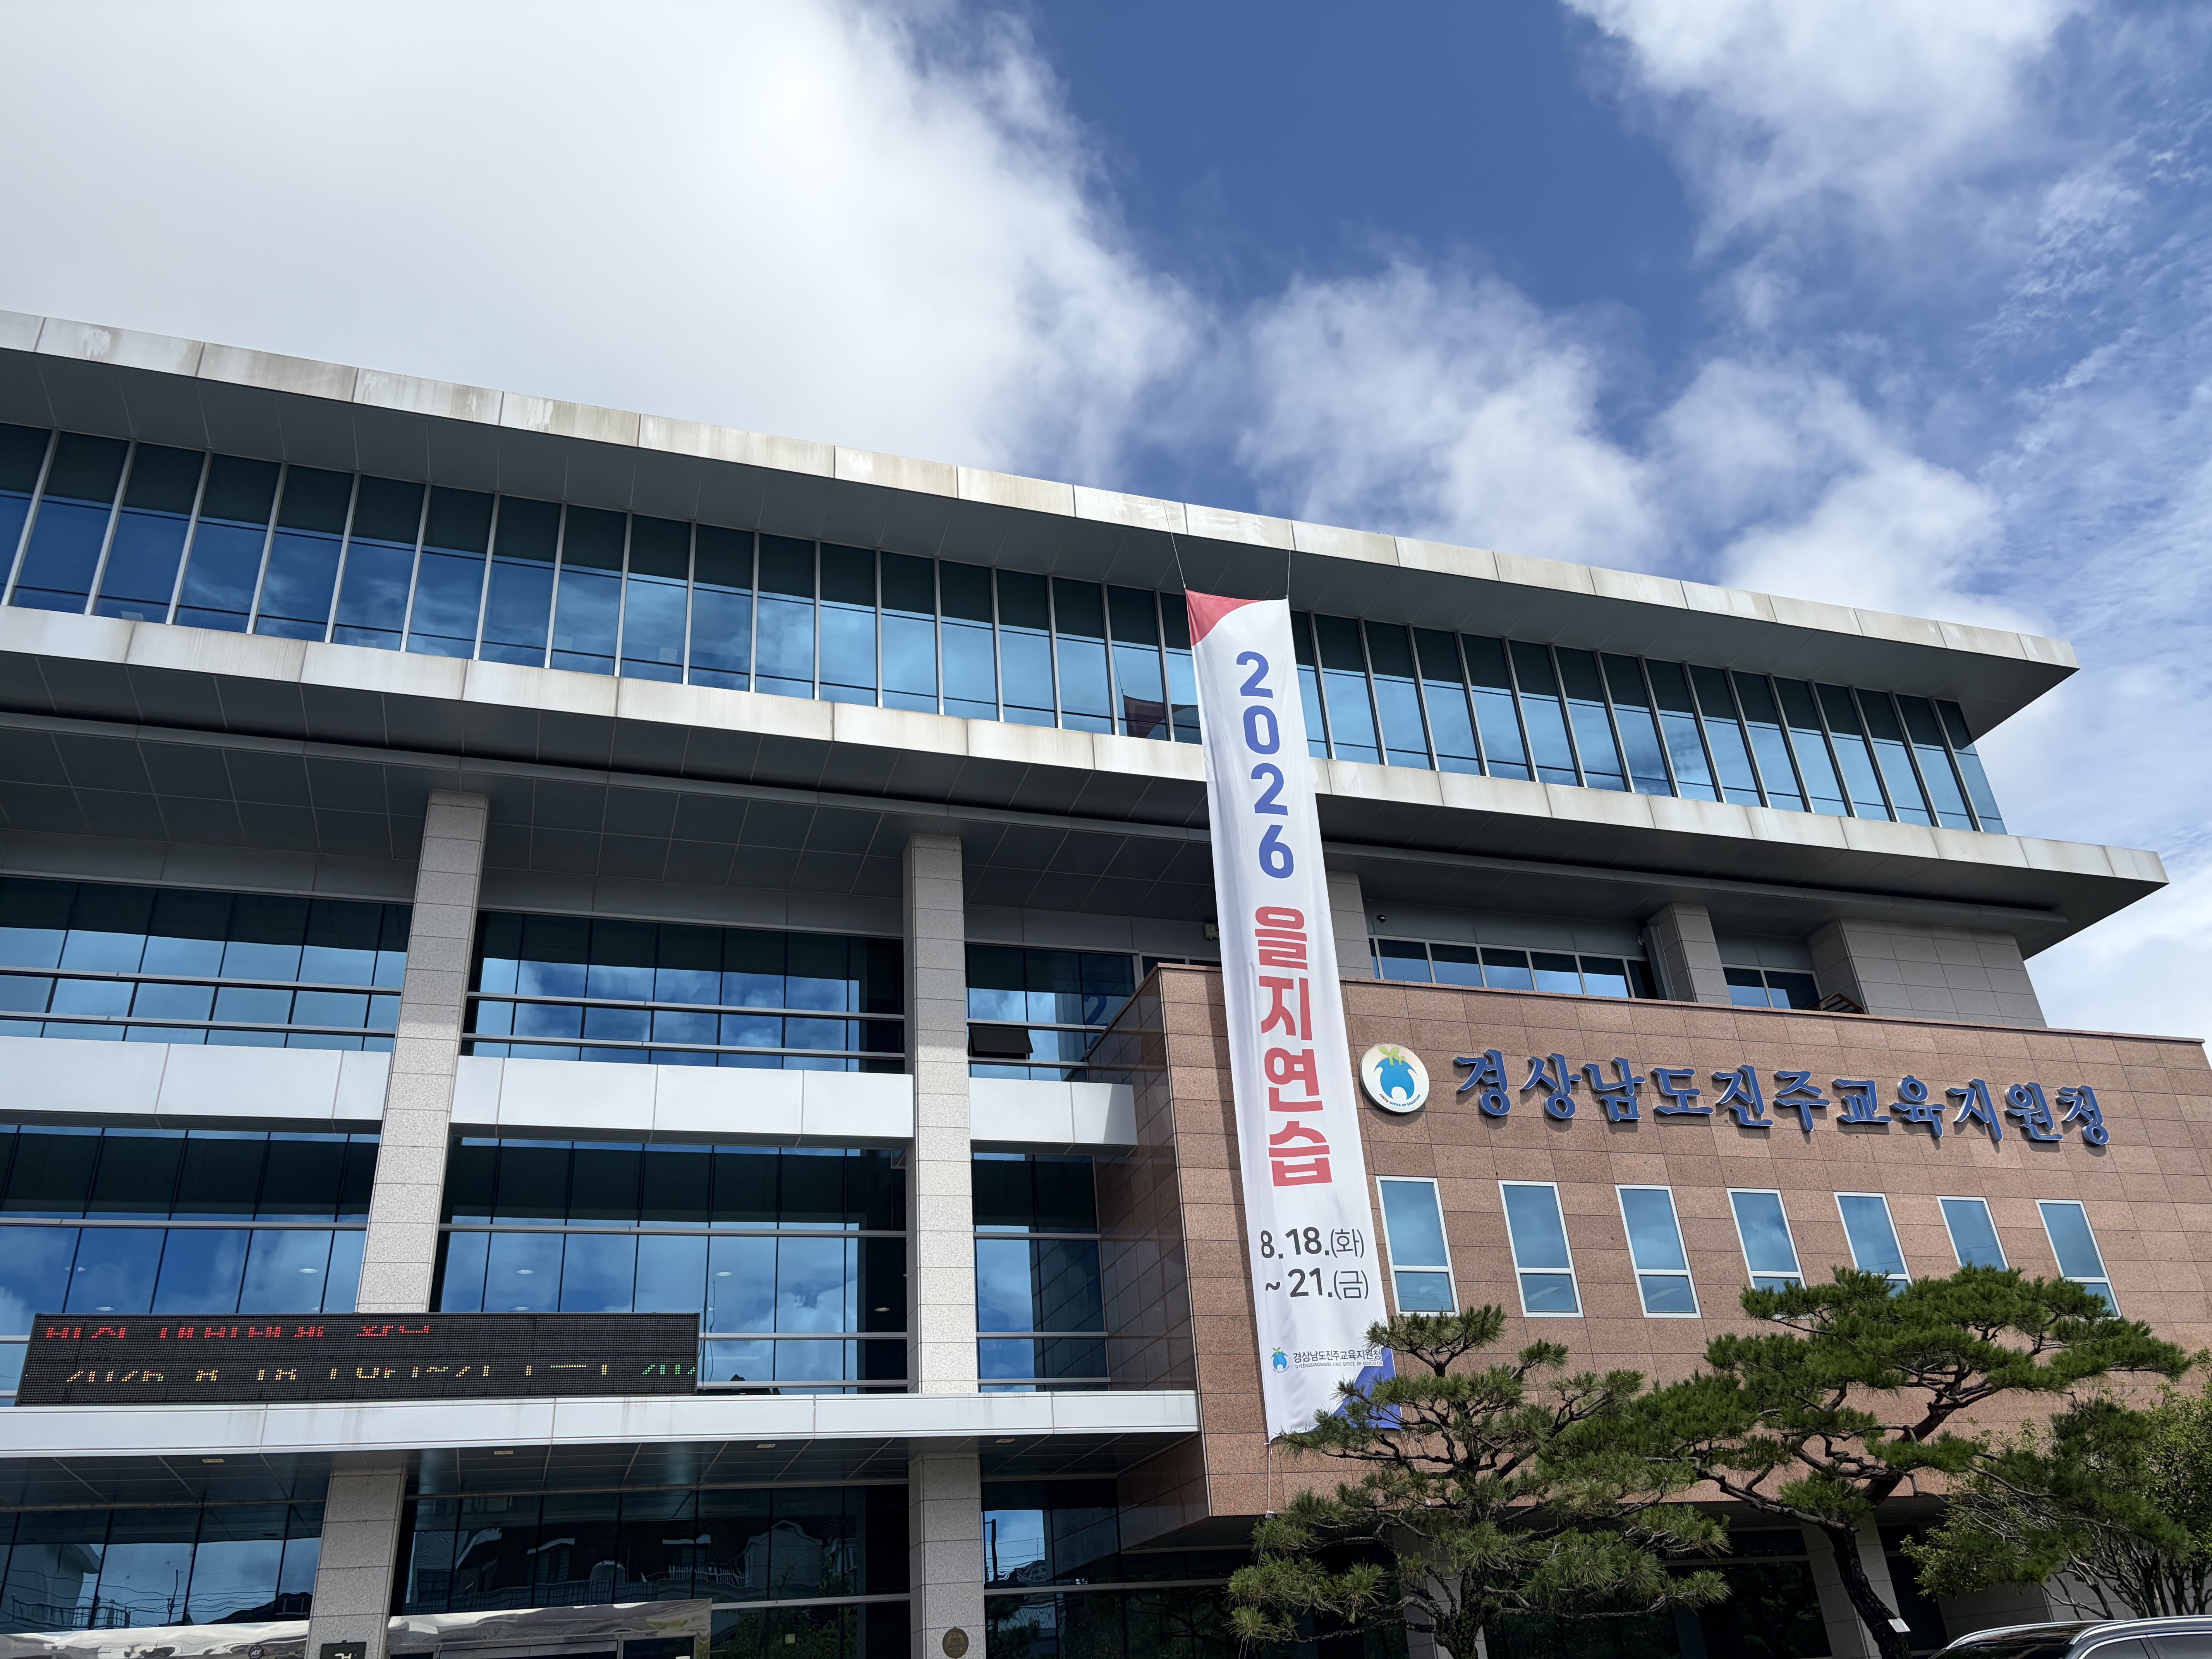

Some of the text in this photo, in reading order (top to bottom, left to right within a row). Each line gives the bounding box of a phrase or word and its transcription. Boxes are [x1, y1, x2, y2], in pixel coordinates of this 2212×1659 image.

[1236, 651, 1333, 1187] 2026 을지연습
[1407, 1094, 1421, 1106] EDUCATION
[1453, 1049, 2110, 1146] 경상남도진주교육지원청
[1261, 1226, 1364, 1259] 8.18.(화)
[1293, 1349, 1382, 1363] 경상남도진주교육지원청
